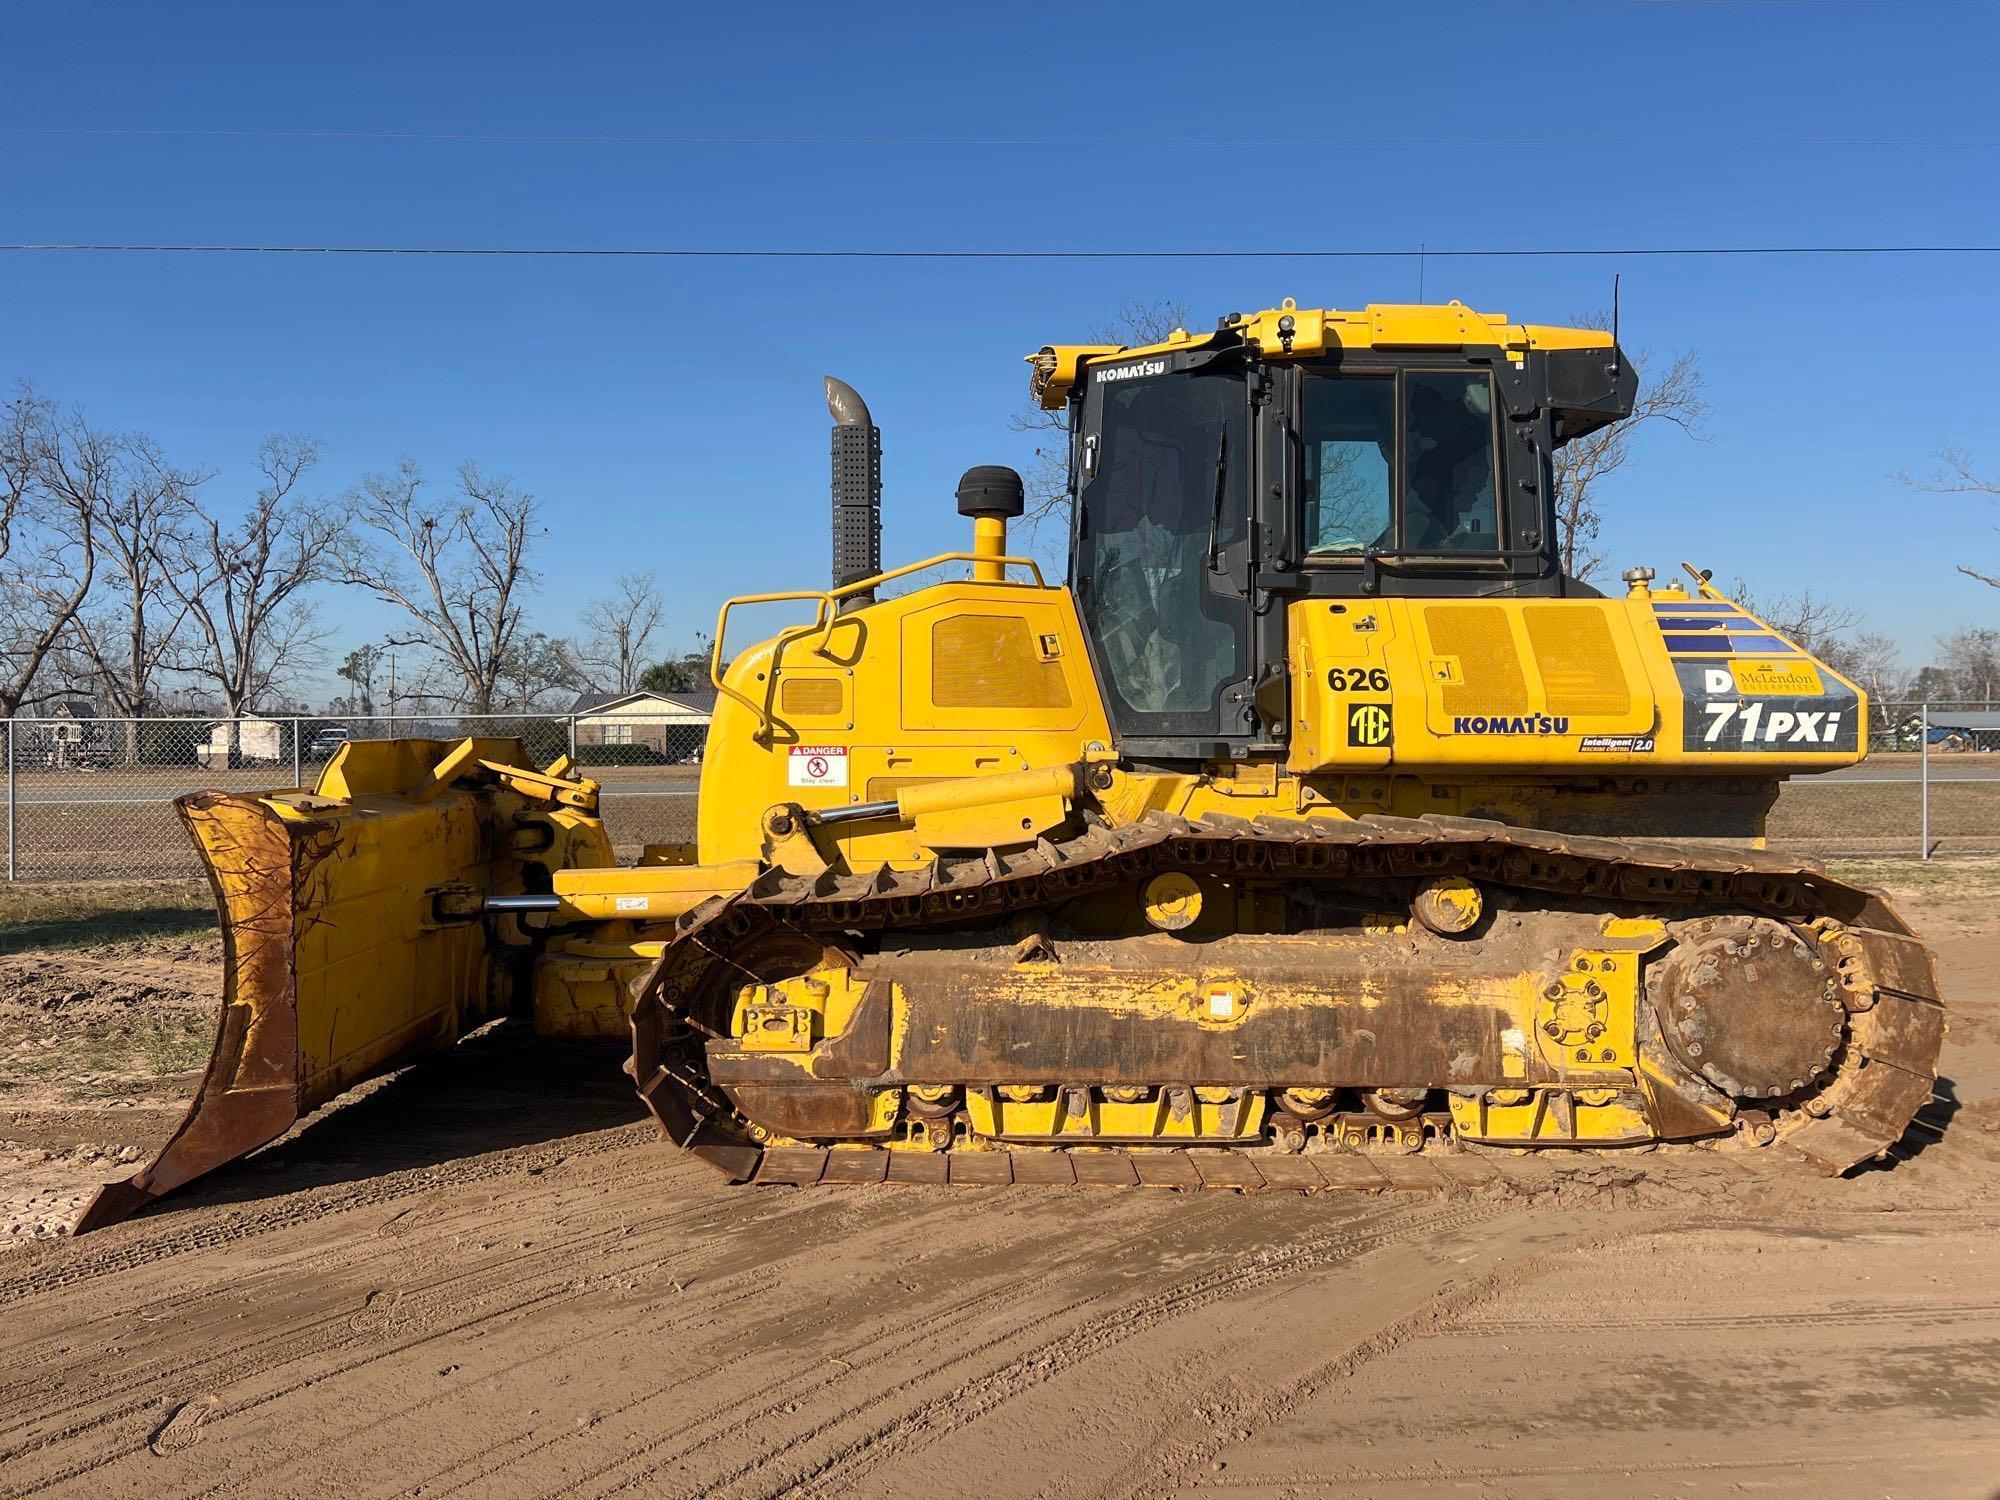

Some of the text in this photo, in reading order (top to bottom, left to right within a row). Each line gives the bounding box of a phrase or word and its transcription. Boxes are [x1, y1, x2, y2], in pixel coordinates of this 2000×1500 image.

[1096, 360, 1165, 383] KOMATSU
[1328, 668, 1390, 692] 626
[1705, 669, 1734, 693] D
[1741, 673, 1813, 684] McLendon
[1454, 712, 1569, 734] KOMATSU
[803, 747, 844, 755] DANGER
[1635, 740, 1653, 751] 2.0
